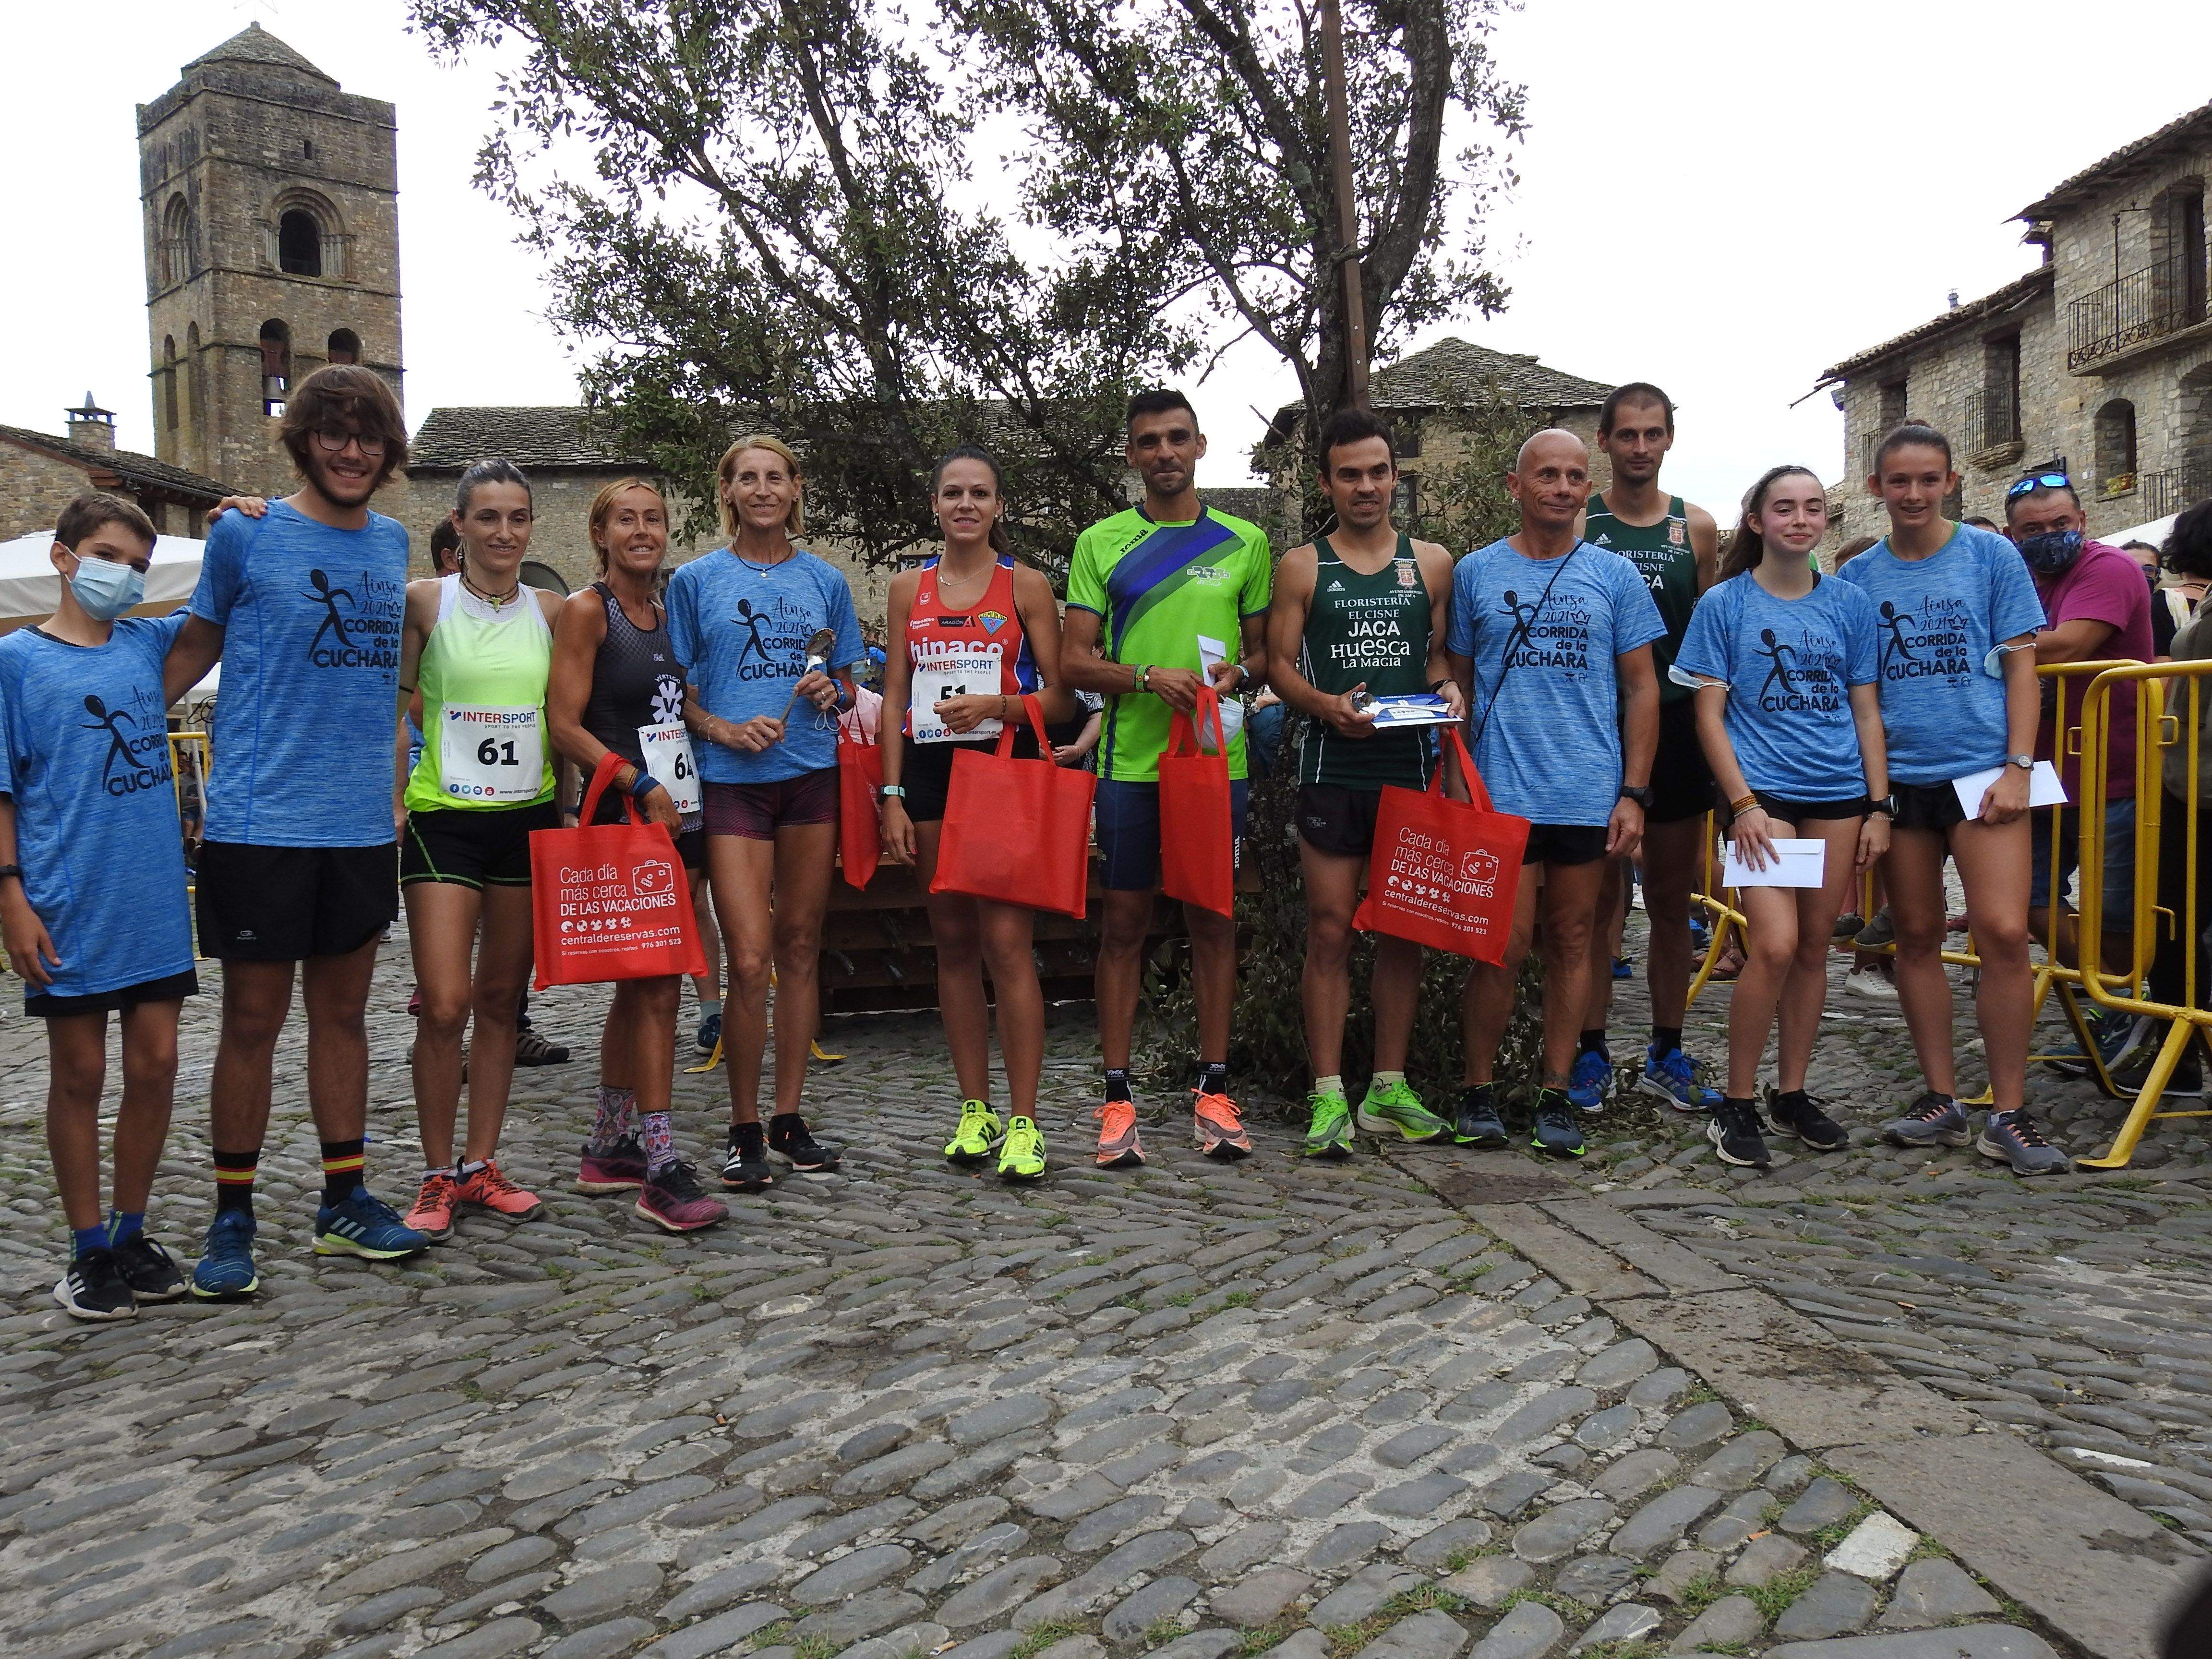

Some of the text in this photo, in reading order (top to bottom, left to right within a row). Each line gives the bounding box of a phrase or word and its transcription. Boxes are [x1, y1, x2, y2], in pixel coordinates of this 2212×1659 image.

[1617, 550, 1674, 563] ORISTERIA
[1641, 574, 1664, 590] CA
[1334, 597, 1411, 609] FLORISTERIA
[1348, 609, 1400, 620] EL CISNE
[1543, 610, 1569, 623] 2021
[343, 618, 400, 635] CORRIDA
[1348, 621, 1401, 637] JACA
[1920, 616, 1947, 631] 2021
[1527, 626, 1589, 640] CORRIDA
[1905, 632, 1967, 648] CORRIDA
[373, 636, 399, 649] de la
[762, 637, 806, 651] CORRID
[1555, 639, 1587, 652] de la
[313, 649, 398, 669] CUCHARA
[790, 651, 802, 662] de
[1935, 645, 1967, 658] de la
[740, 661, 807, 681] CUCHAR
[927, 659, 994, 672] INTERSPORT
[1886, 658, 1971, 681] CUCHARA
[1811, 683, 1839, 694] de la
[1762, 695, 1839, 712] CUCHARA
[463, 711, 536, 724] INTERSPORT
[477, 737, 519, 766] 61
[1399, 827, 1450, 856] Cada día
[1395, 846, 1454, 876] más cerca
[560, 863, 618, 884] Cada día
[1391, 859, 1494, 898] DE LAS VACACIONES
[560, 884, 628, 901] más cerca
[560, 893, 676, 916] DE LAS VACACIONES
[1384, 890, 1489, 925] centraldereservas.com
[561, 926, 681, 946] centraldereservas.com
[1451, 922, 1462, 930] 976
[1475, 927, 1487, 935] 523
